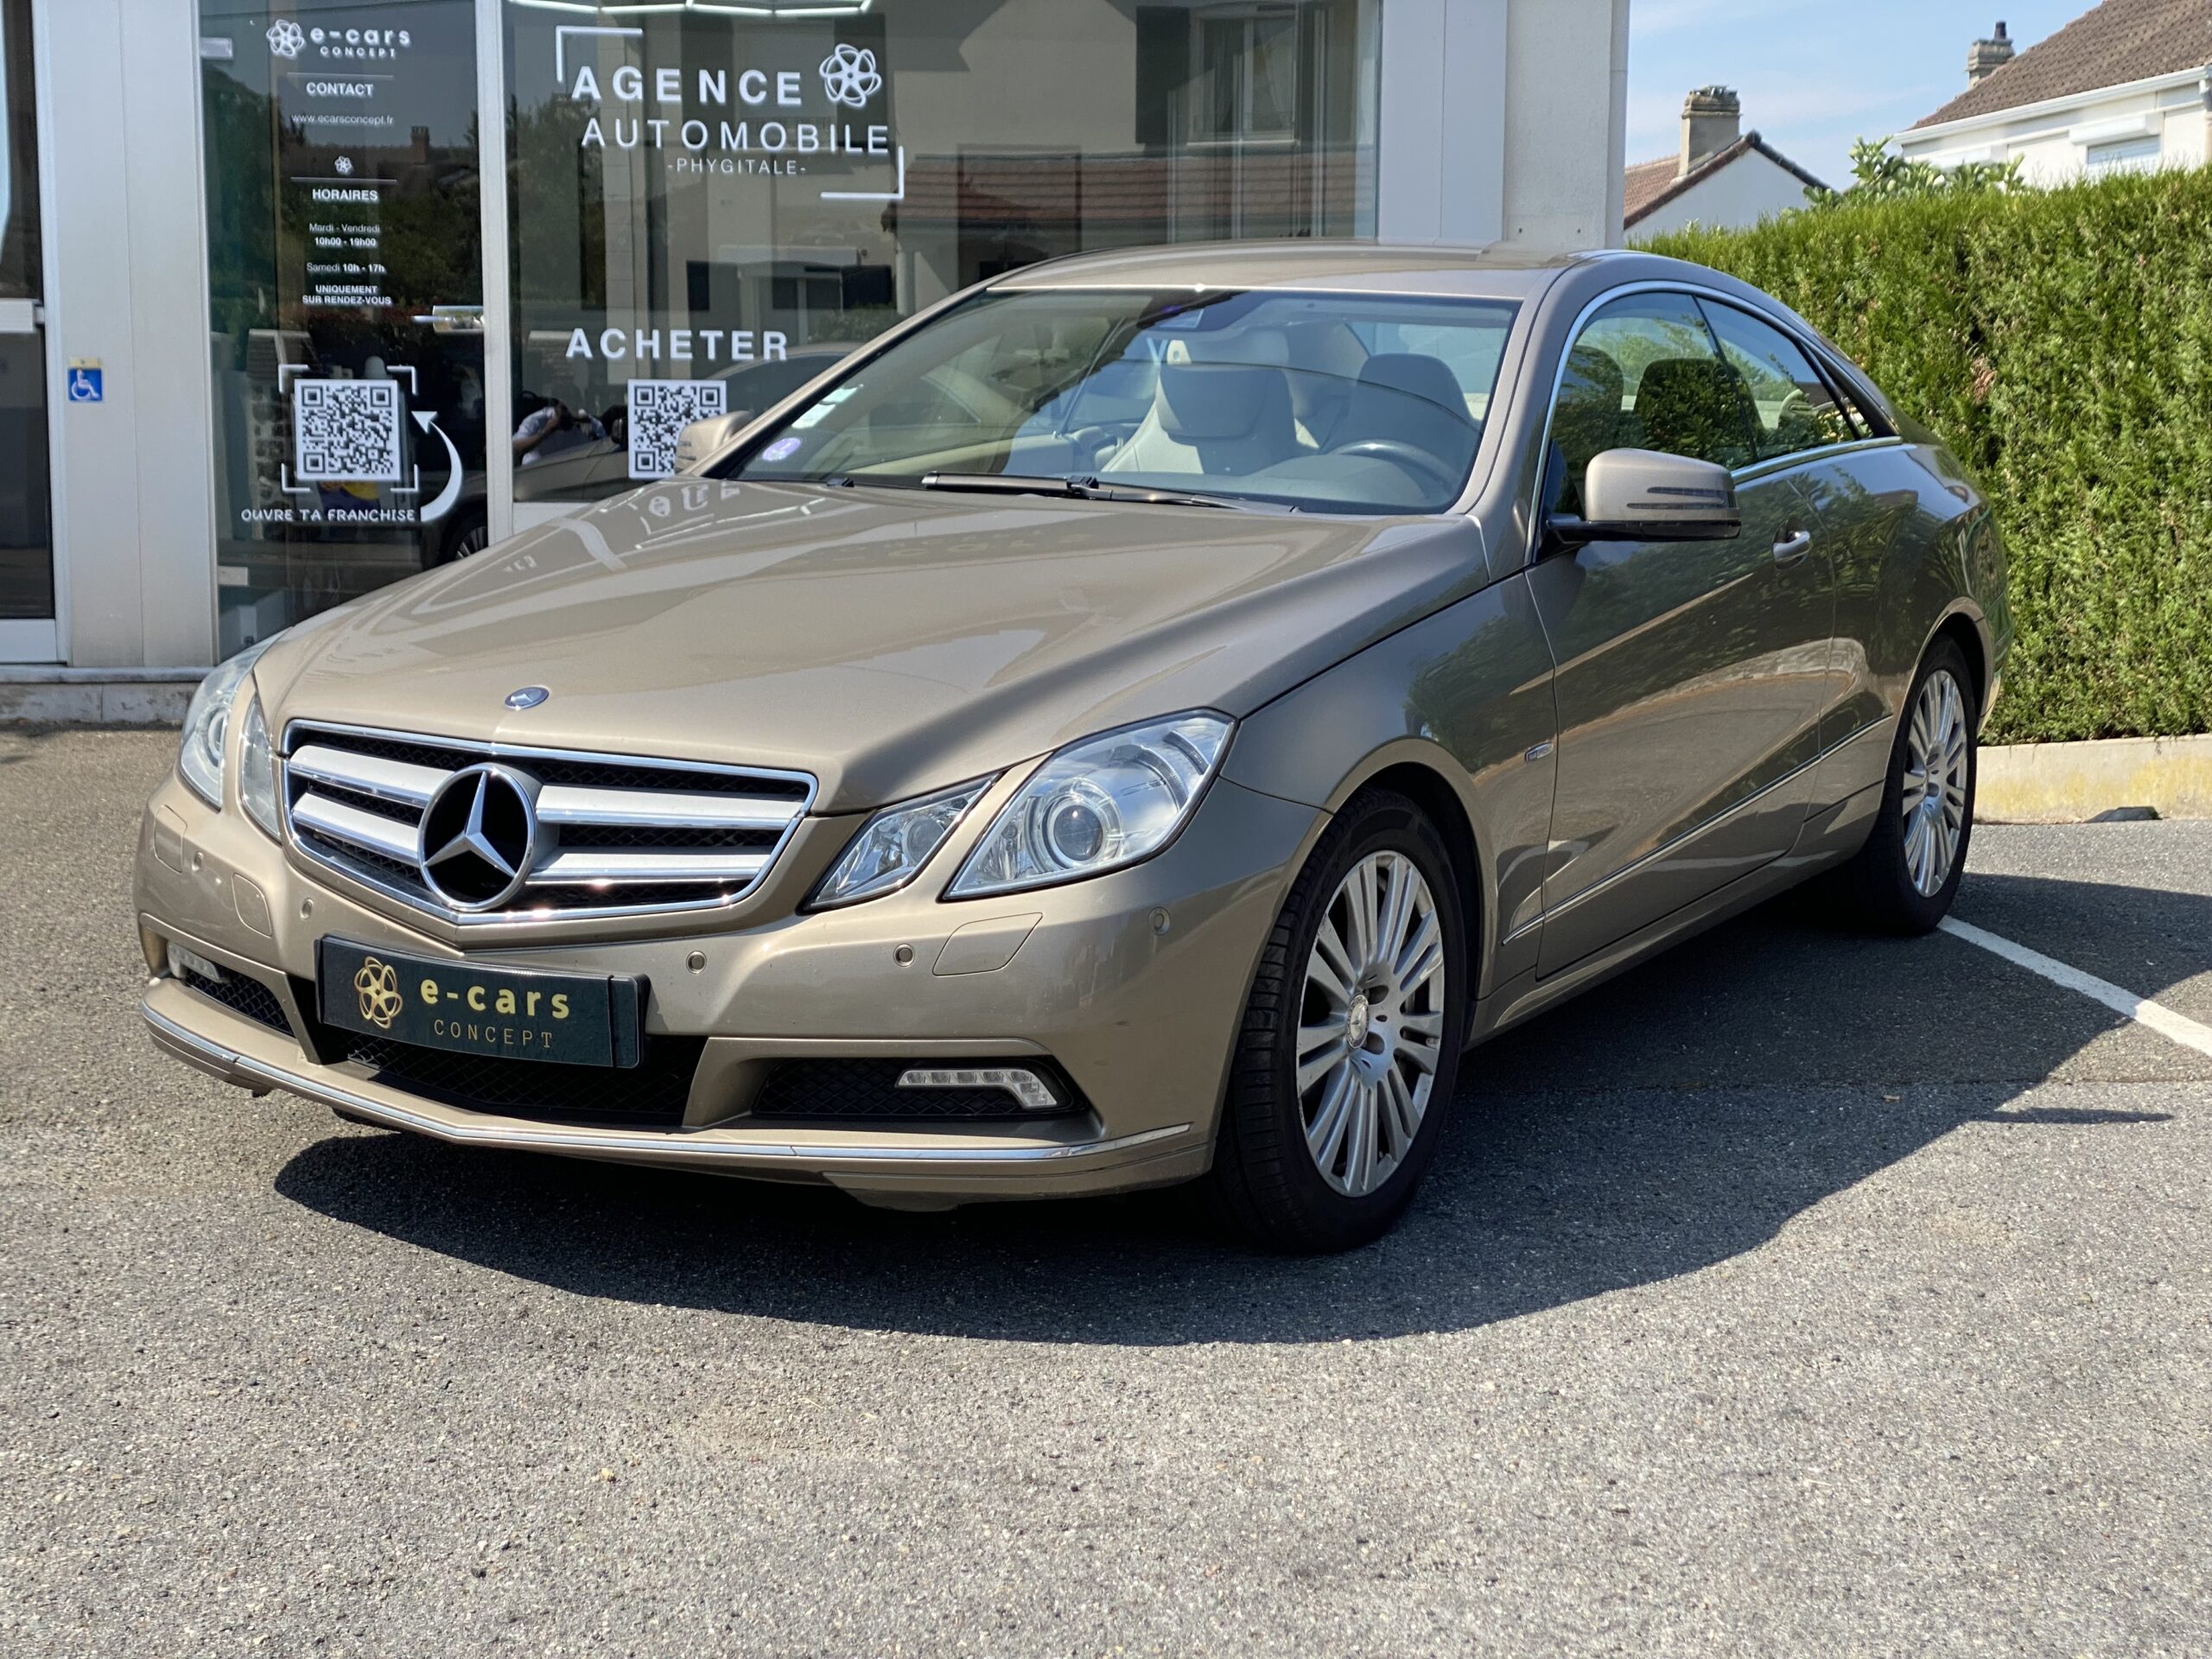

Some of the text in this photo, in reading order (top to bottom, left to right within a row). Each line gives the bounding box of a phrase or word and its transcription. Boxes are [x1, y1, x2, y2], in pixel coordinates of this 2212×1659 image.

[309, 27, 411, 47] e-cars
[319, 46, 397, 60] CONCEPT
[306, 82, 374, 97] CONTACT
[571, 66, 803, 106] AGENCE
[290, 114, 394, 125] www.ecarsconcept.fr
[581, 118, 889, 154] AUTOMOBILE
[312, 188, 379, 202] HORAIRES
[308, 223, 334, 232] Mardi
[341, 223, 380, 233] Vendredi
[314, 237, 340, 247] 10h00
[349, 237, 377, 247] 19h00
[306, 262, 340, 273] Samedi
[342, 263, 359, 272] 10h
[368, 263, 385, 273] 17h
[315, 284, 378, 295] UNIQUEMENT
[302, 295, 392, 306] SUR RENDEZ-VOUS
[565, 327, 789, 362] ACHETER
[241, 508, 416, 522] OUVRE TA FRANCHISE
[420, 978, 570, 1020] e-cars
[434, 1019, 553, 1049] CONCEPT
